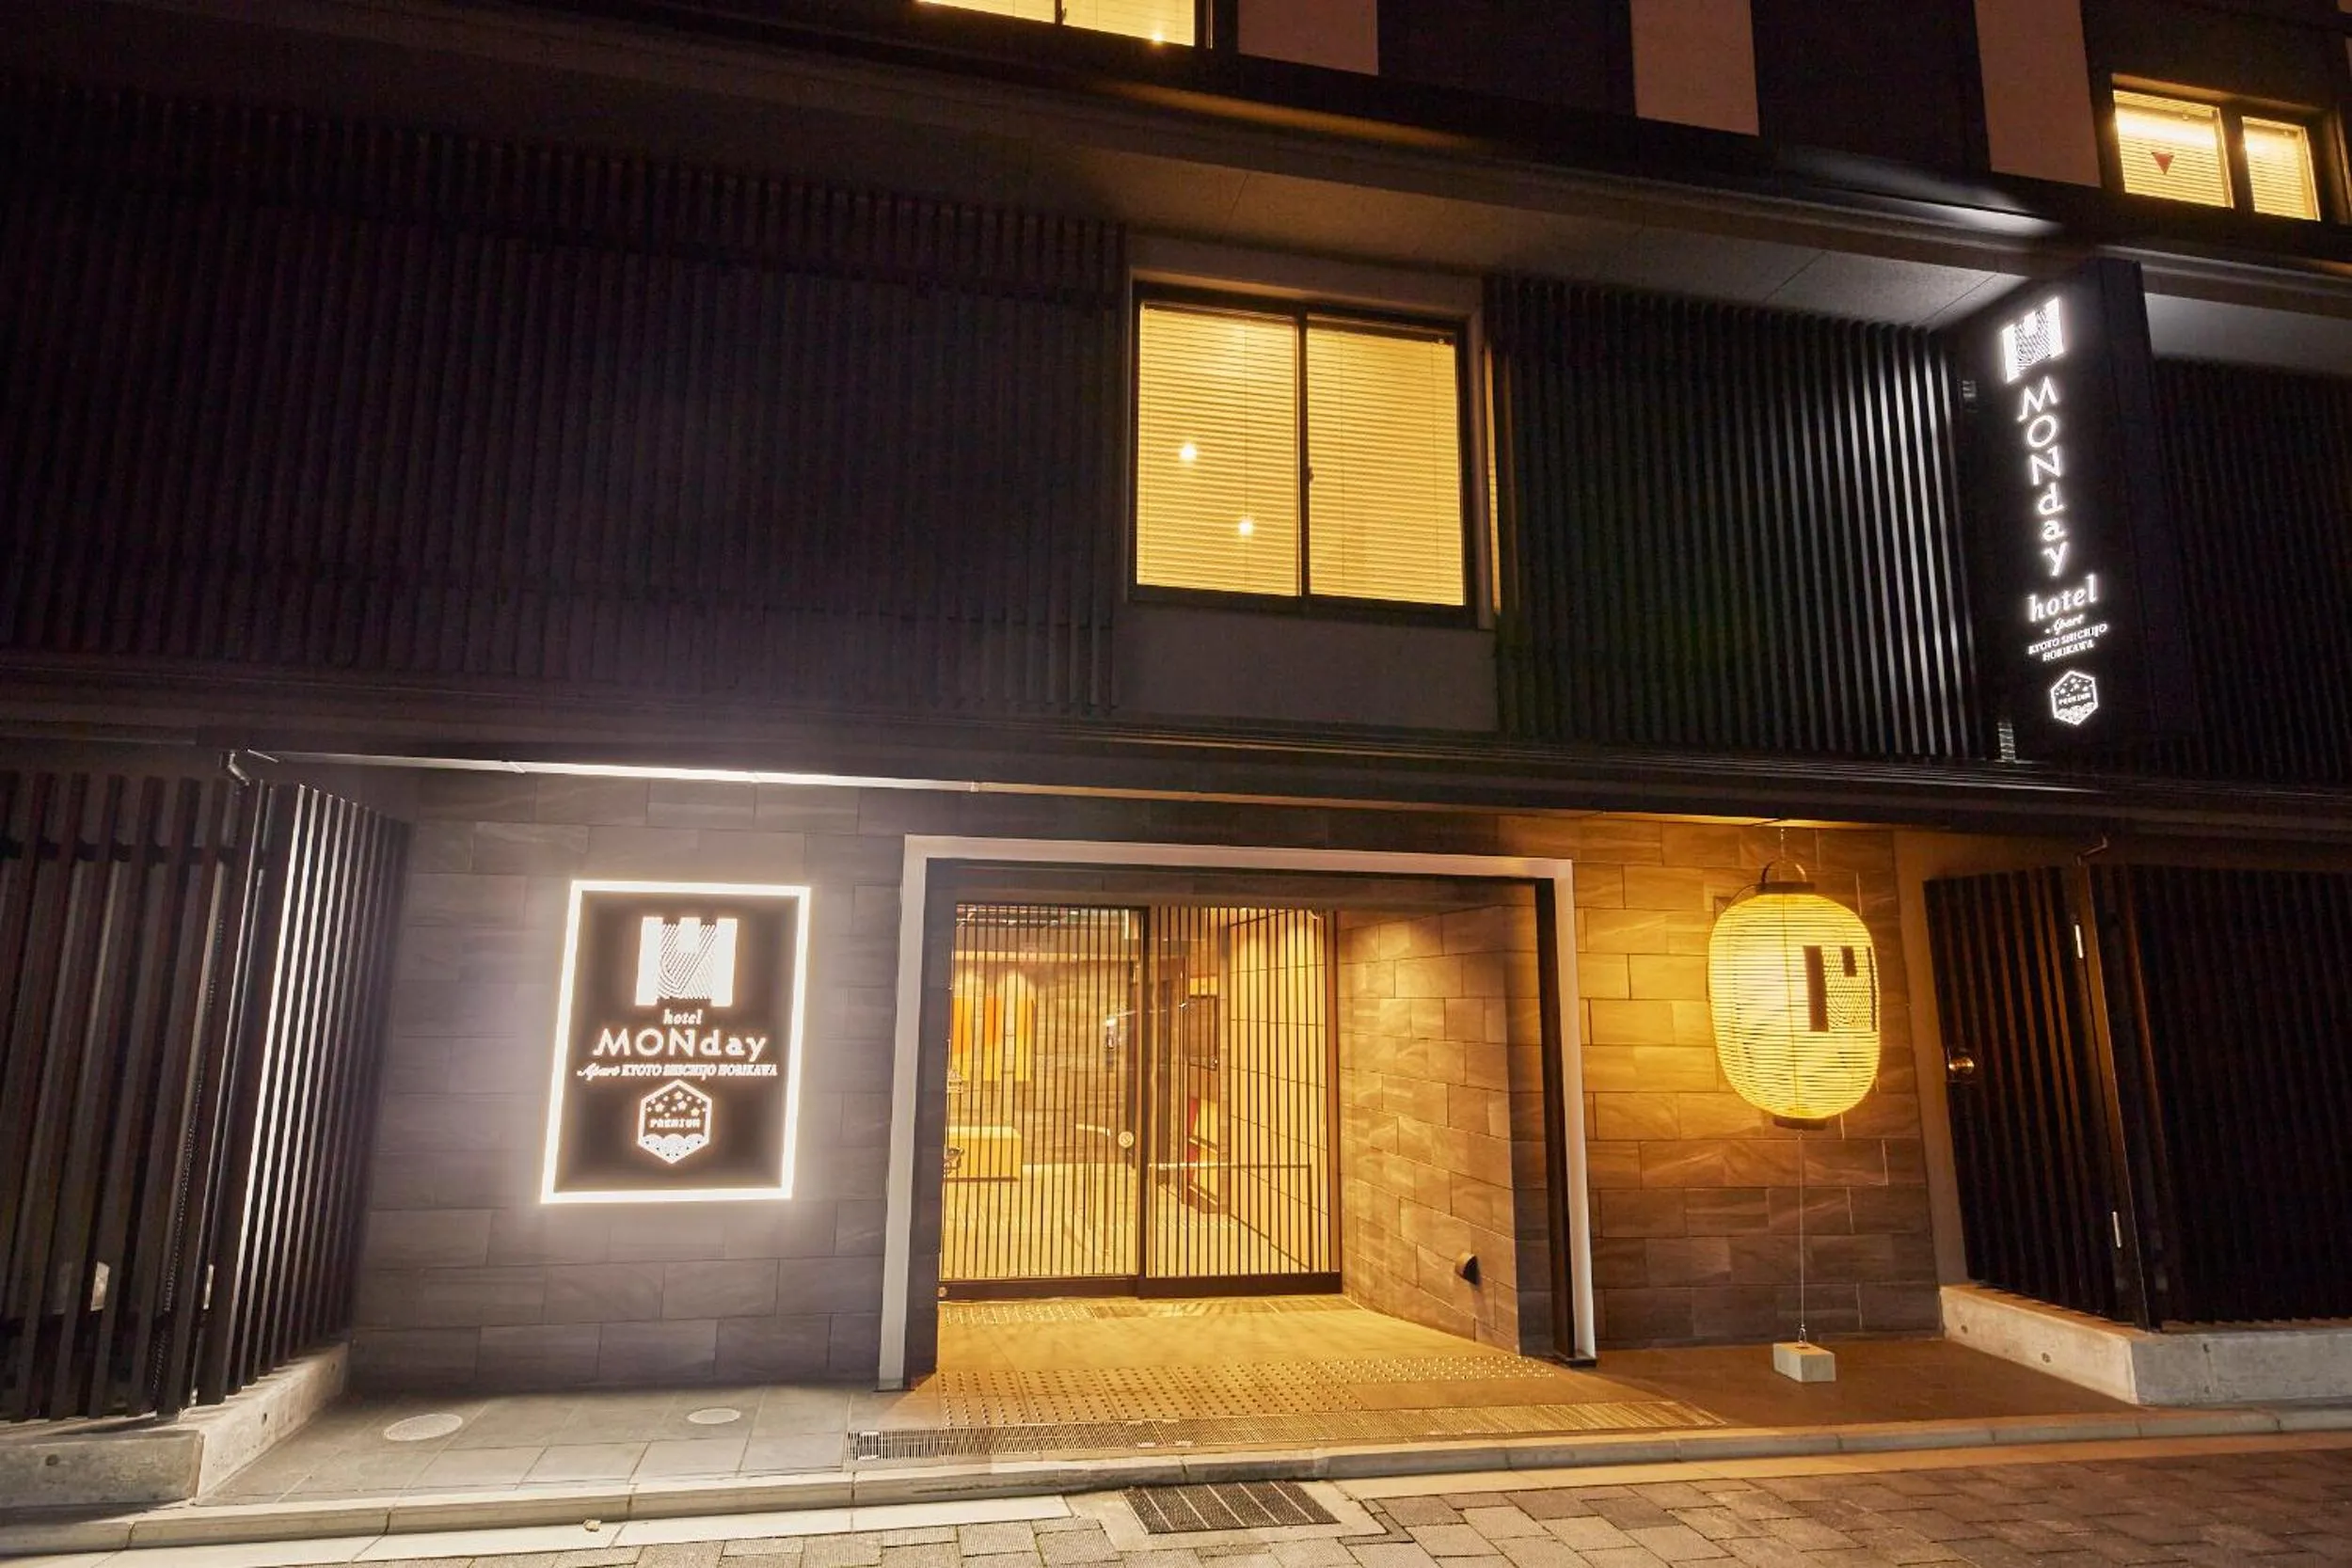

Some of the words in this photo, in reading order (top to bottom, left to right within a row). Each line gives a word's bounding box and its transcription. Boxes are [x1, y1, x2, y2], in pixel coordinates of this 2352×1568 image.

[2017, 375, 2069, 577] MONday
[2026, 573, 2098, 622] hotel
[2028, 638, 2060, 656] KYOTO
[663, 1008, 703, 1025] hotel
[592, 1027, 767, 1062] MONday
[620, 1064, 662, 1077] KYOTO
